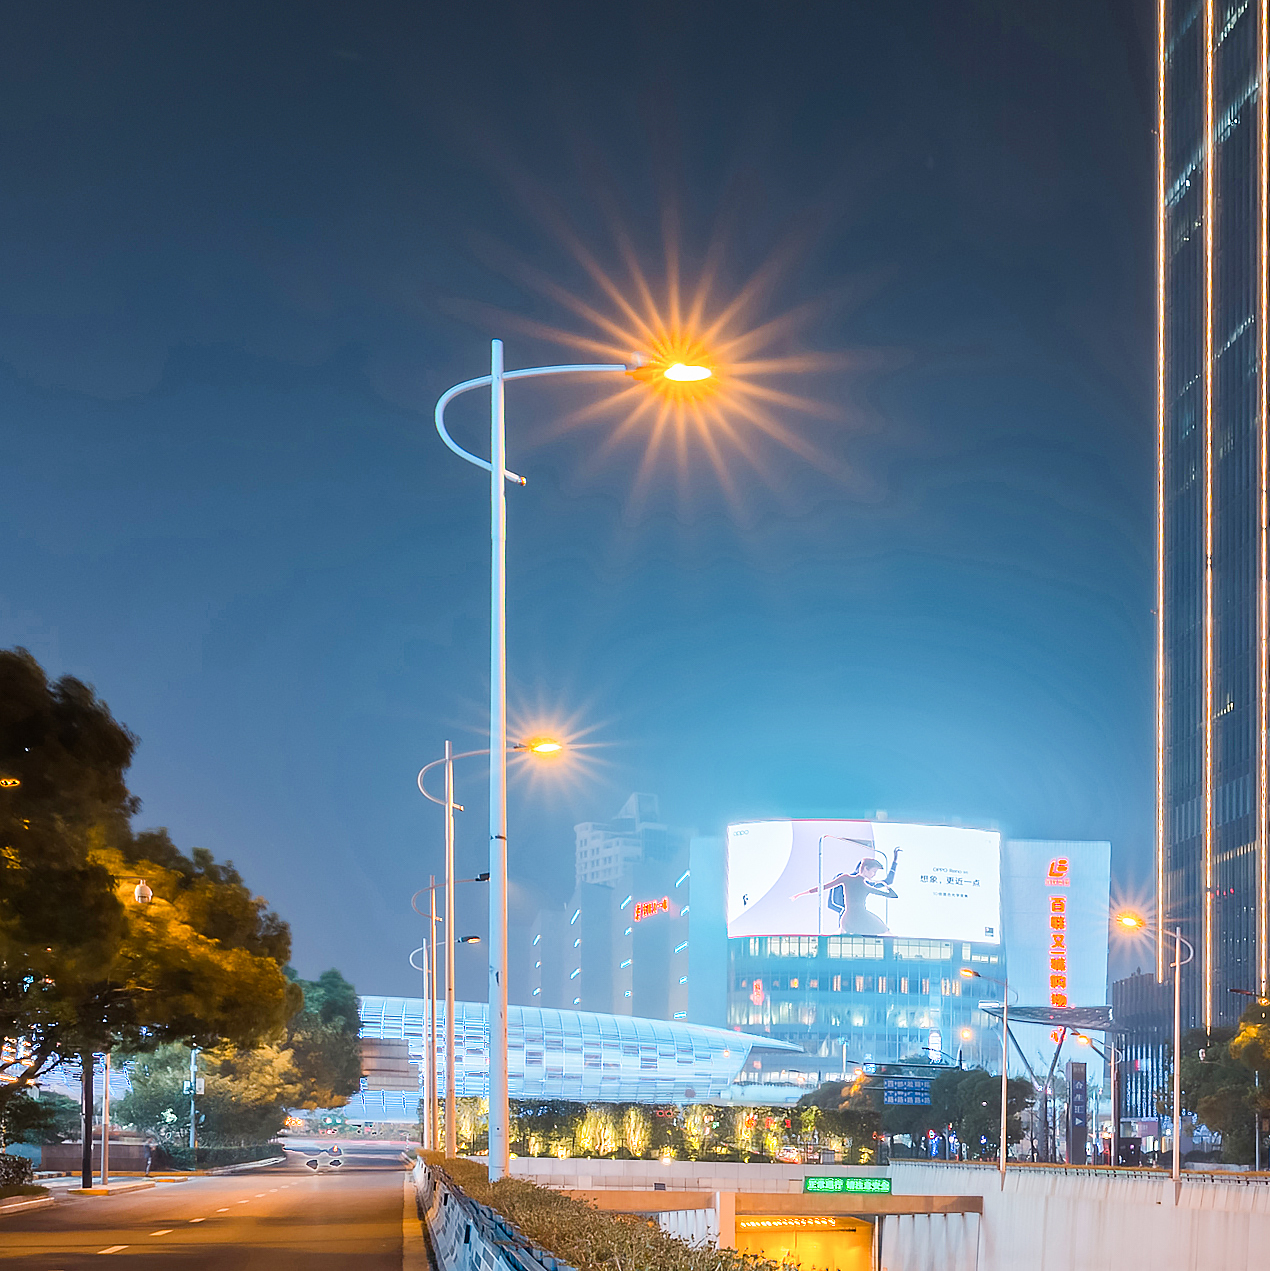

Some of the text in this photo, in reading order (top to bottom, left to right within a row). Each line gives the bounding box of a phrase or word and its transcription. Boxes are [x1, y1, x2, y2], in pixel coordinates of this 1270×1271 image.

[1049, 894, 1069, 1045] 百联又一城购物心
[1074, 1081, 1085, 1114] 合生汇
